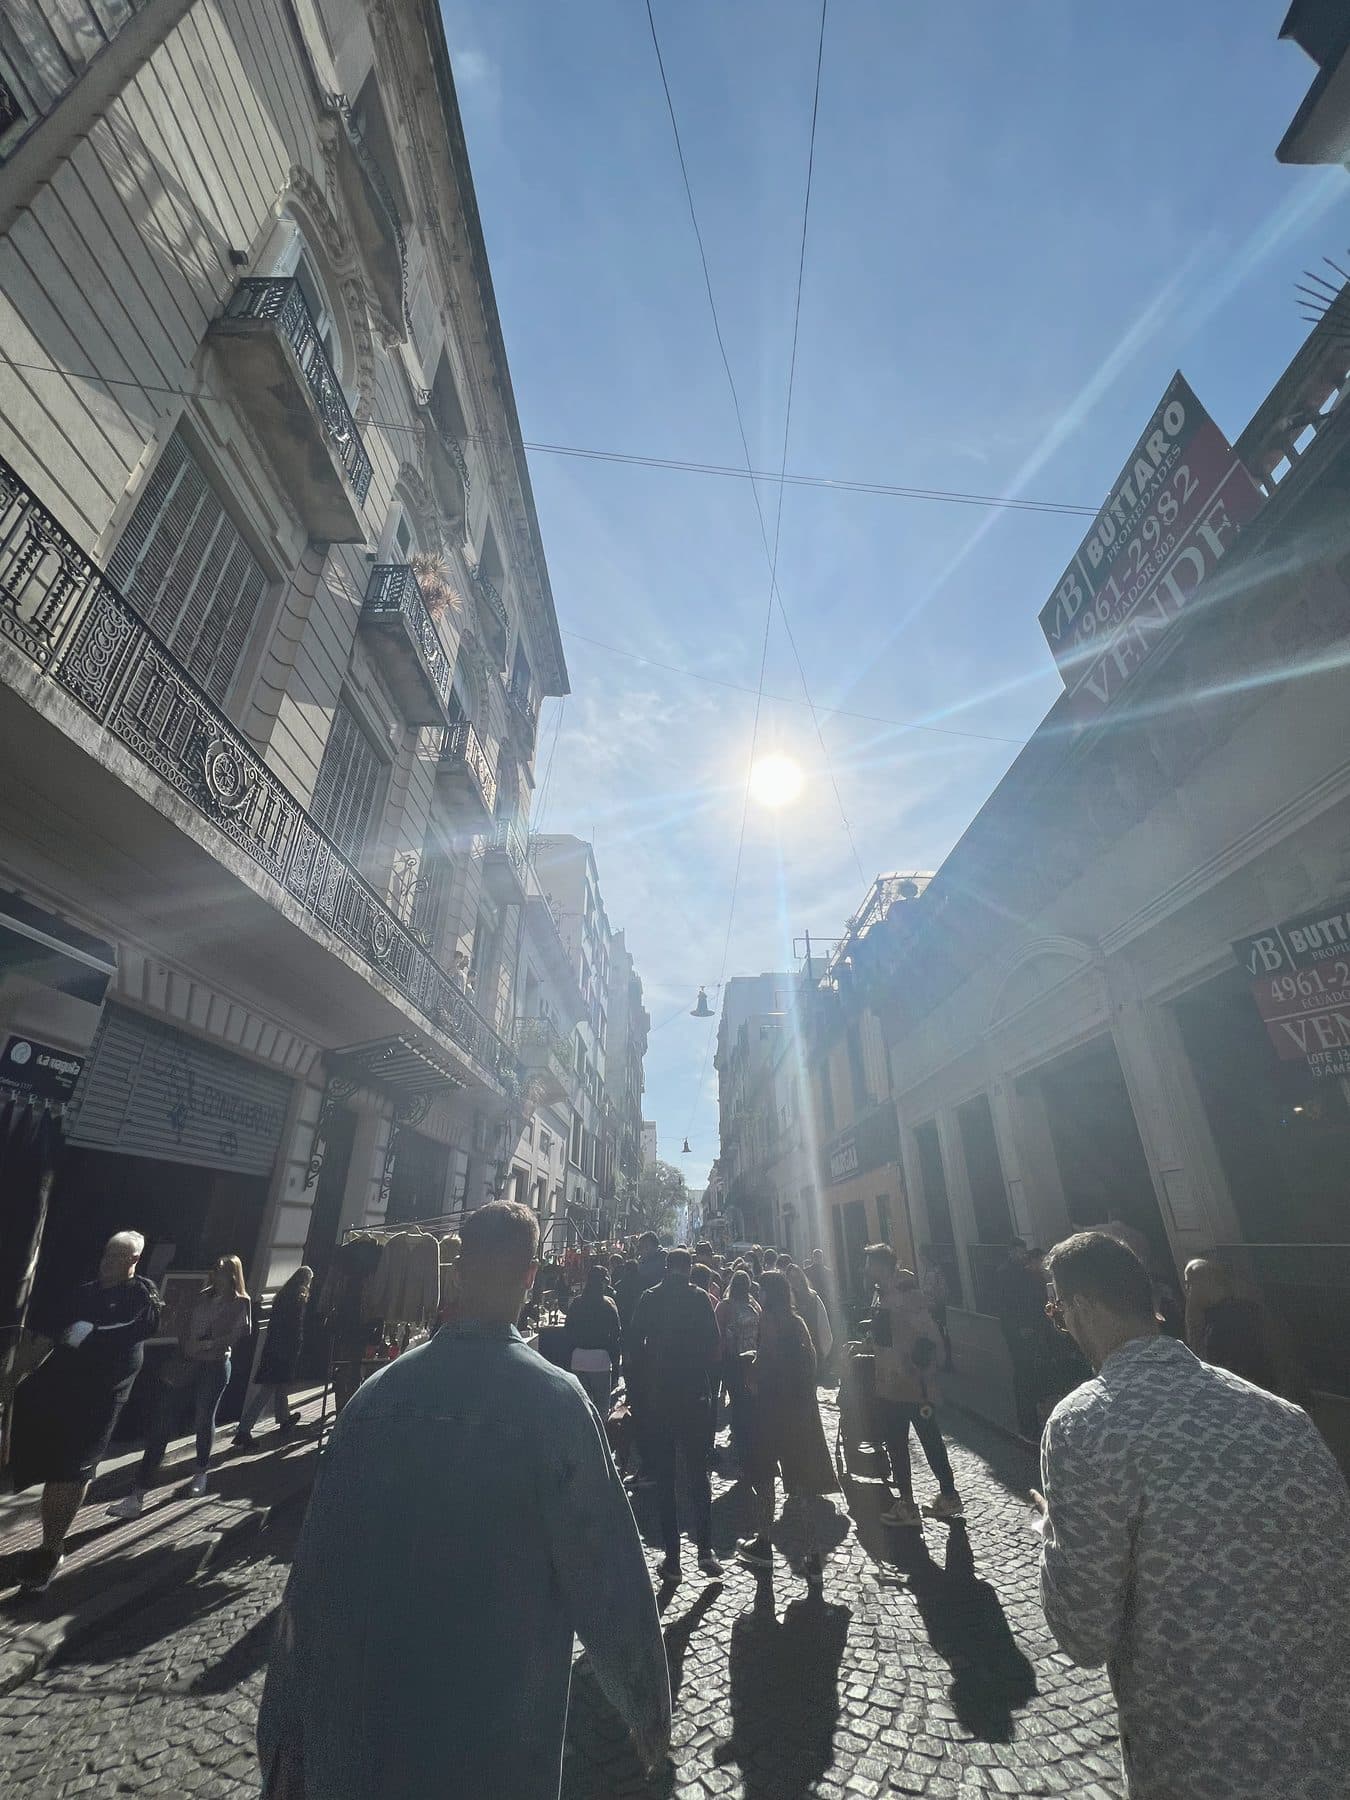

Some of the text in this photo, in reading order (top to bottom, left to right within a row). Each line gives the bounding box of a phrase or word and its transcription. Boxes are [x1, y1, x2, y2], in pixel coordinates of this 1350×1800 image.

[1087, 400, 1186, 569] BUTTARO
[1154, 533, 1177, 564] 803
[1288, 912, 1350, 953] BUTT
